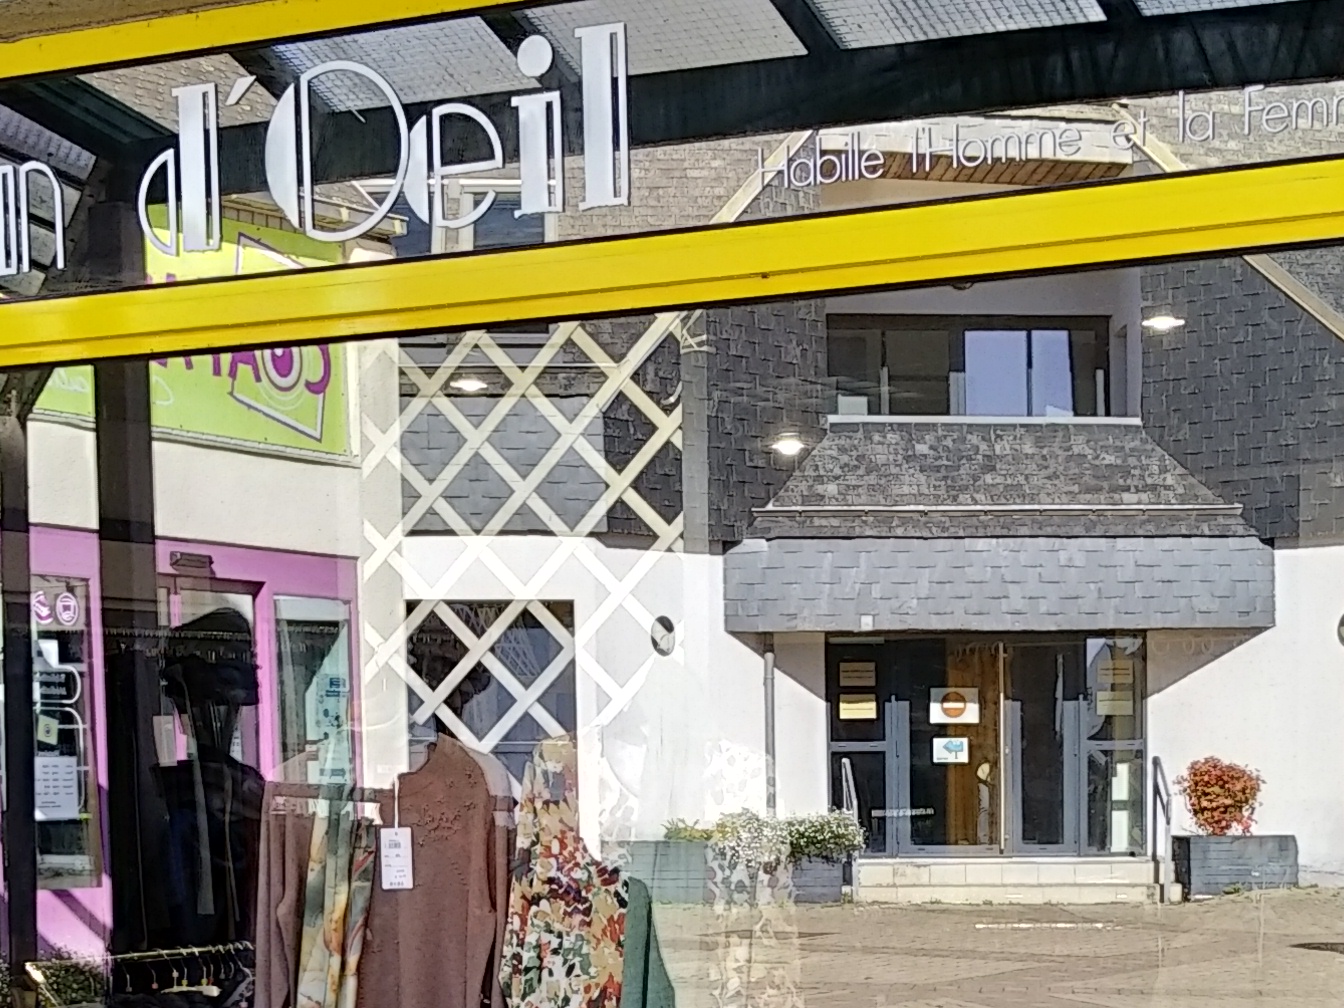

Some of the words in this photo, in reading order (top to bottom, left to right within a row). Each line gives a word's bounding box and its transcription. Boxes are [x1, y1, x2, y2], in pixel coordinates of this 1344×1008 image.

[137, 21, 630, 257] d'Oeil
[756, 131, 885, 190] Habille
[912, 122, 1083, 174] l'Homme
[1111, 107, 1147, 149] et
[1177, 90, 1216, 143] la
